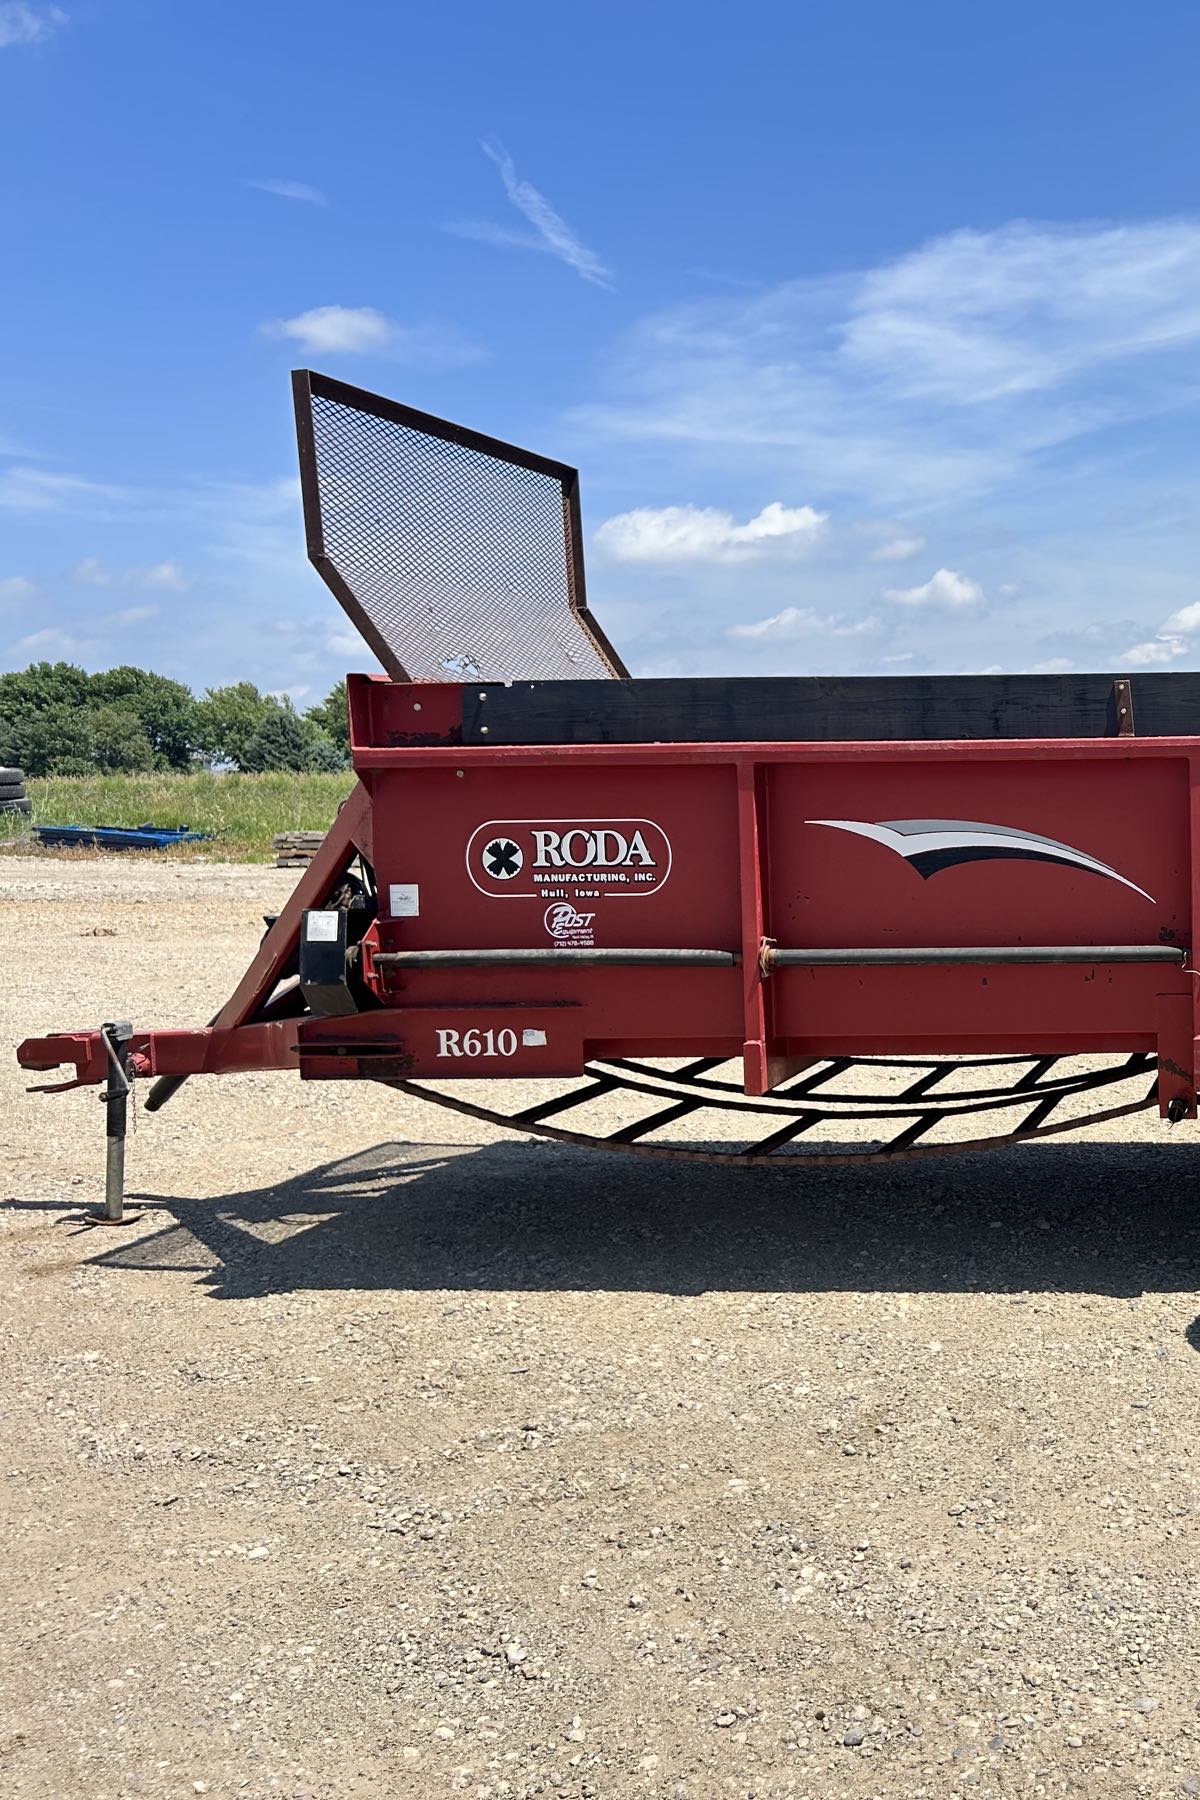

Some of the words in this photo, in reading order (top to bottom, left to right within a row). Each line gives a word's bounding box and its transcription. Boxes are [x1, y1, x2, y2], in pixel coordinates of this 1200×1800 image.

[531, 829, 657, 868] RODA
[533, 873, 630, 884] MANUFACTURING,
[634, 873, 657, 882] INC.
[541, 889, 570, 899] Hull,
[575, 889, 600, 898] Iowa
[435, 1028, 518, 1057] R610
